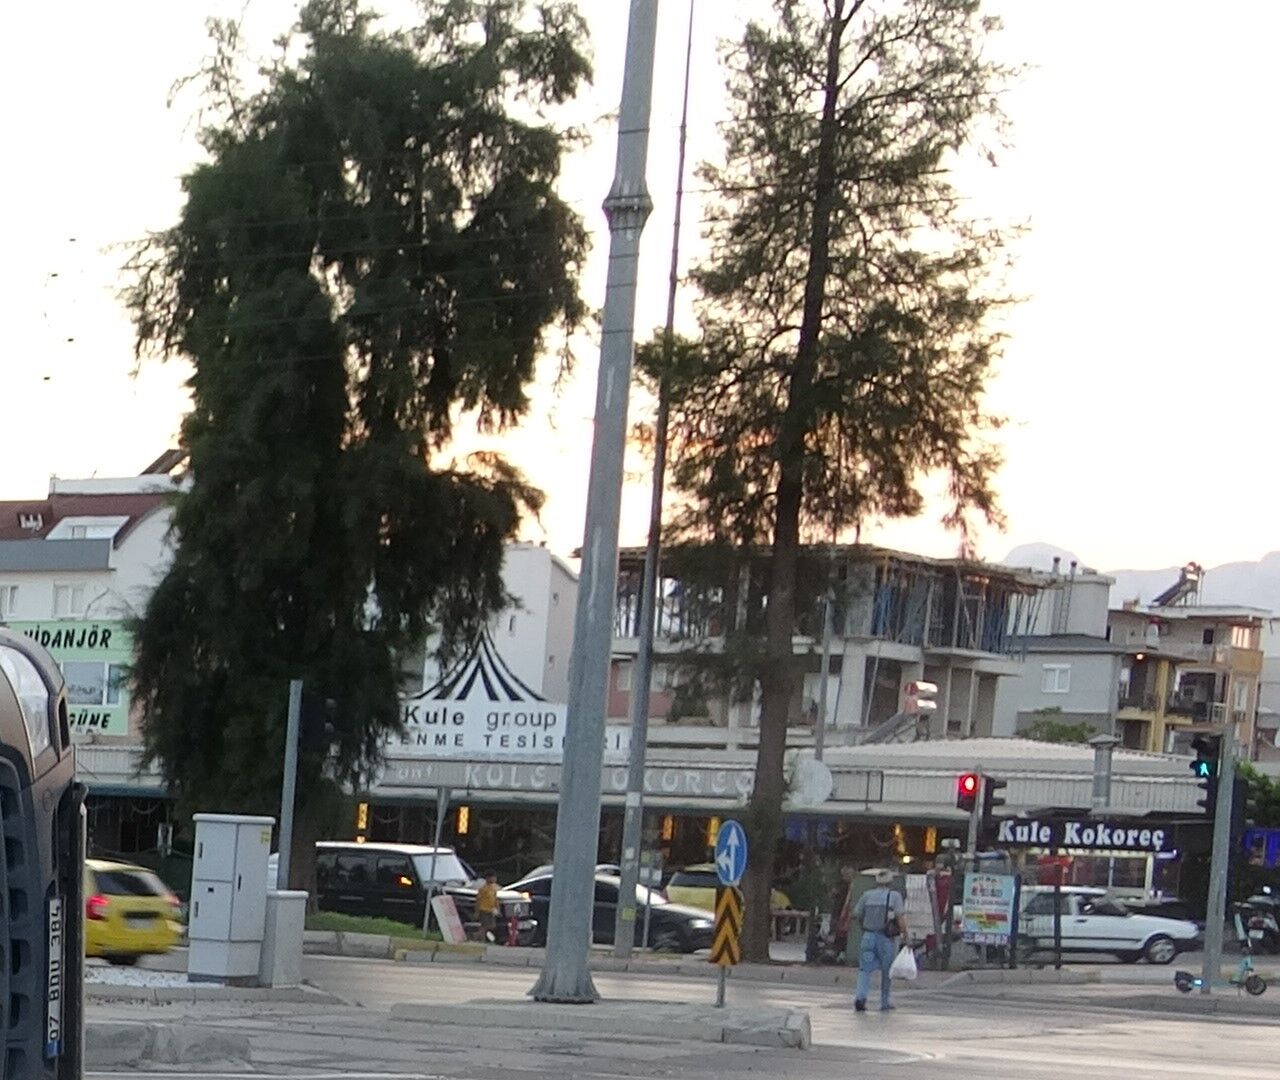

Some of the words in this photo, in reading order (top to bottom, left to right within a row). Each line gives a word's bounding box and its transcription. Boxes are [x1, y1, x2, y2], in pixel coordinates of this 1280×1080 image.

[403, 706, 465, 726] Kule
[486, 710, 557, 731] group
[385, 733, 464, 747] LENME
[998, 820, 1051, 843] Kule
[1063, 822, 1165, 850] Kokoreç
[49, 1016, 59, 1041] 07
